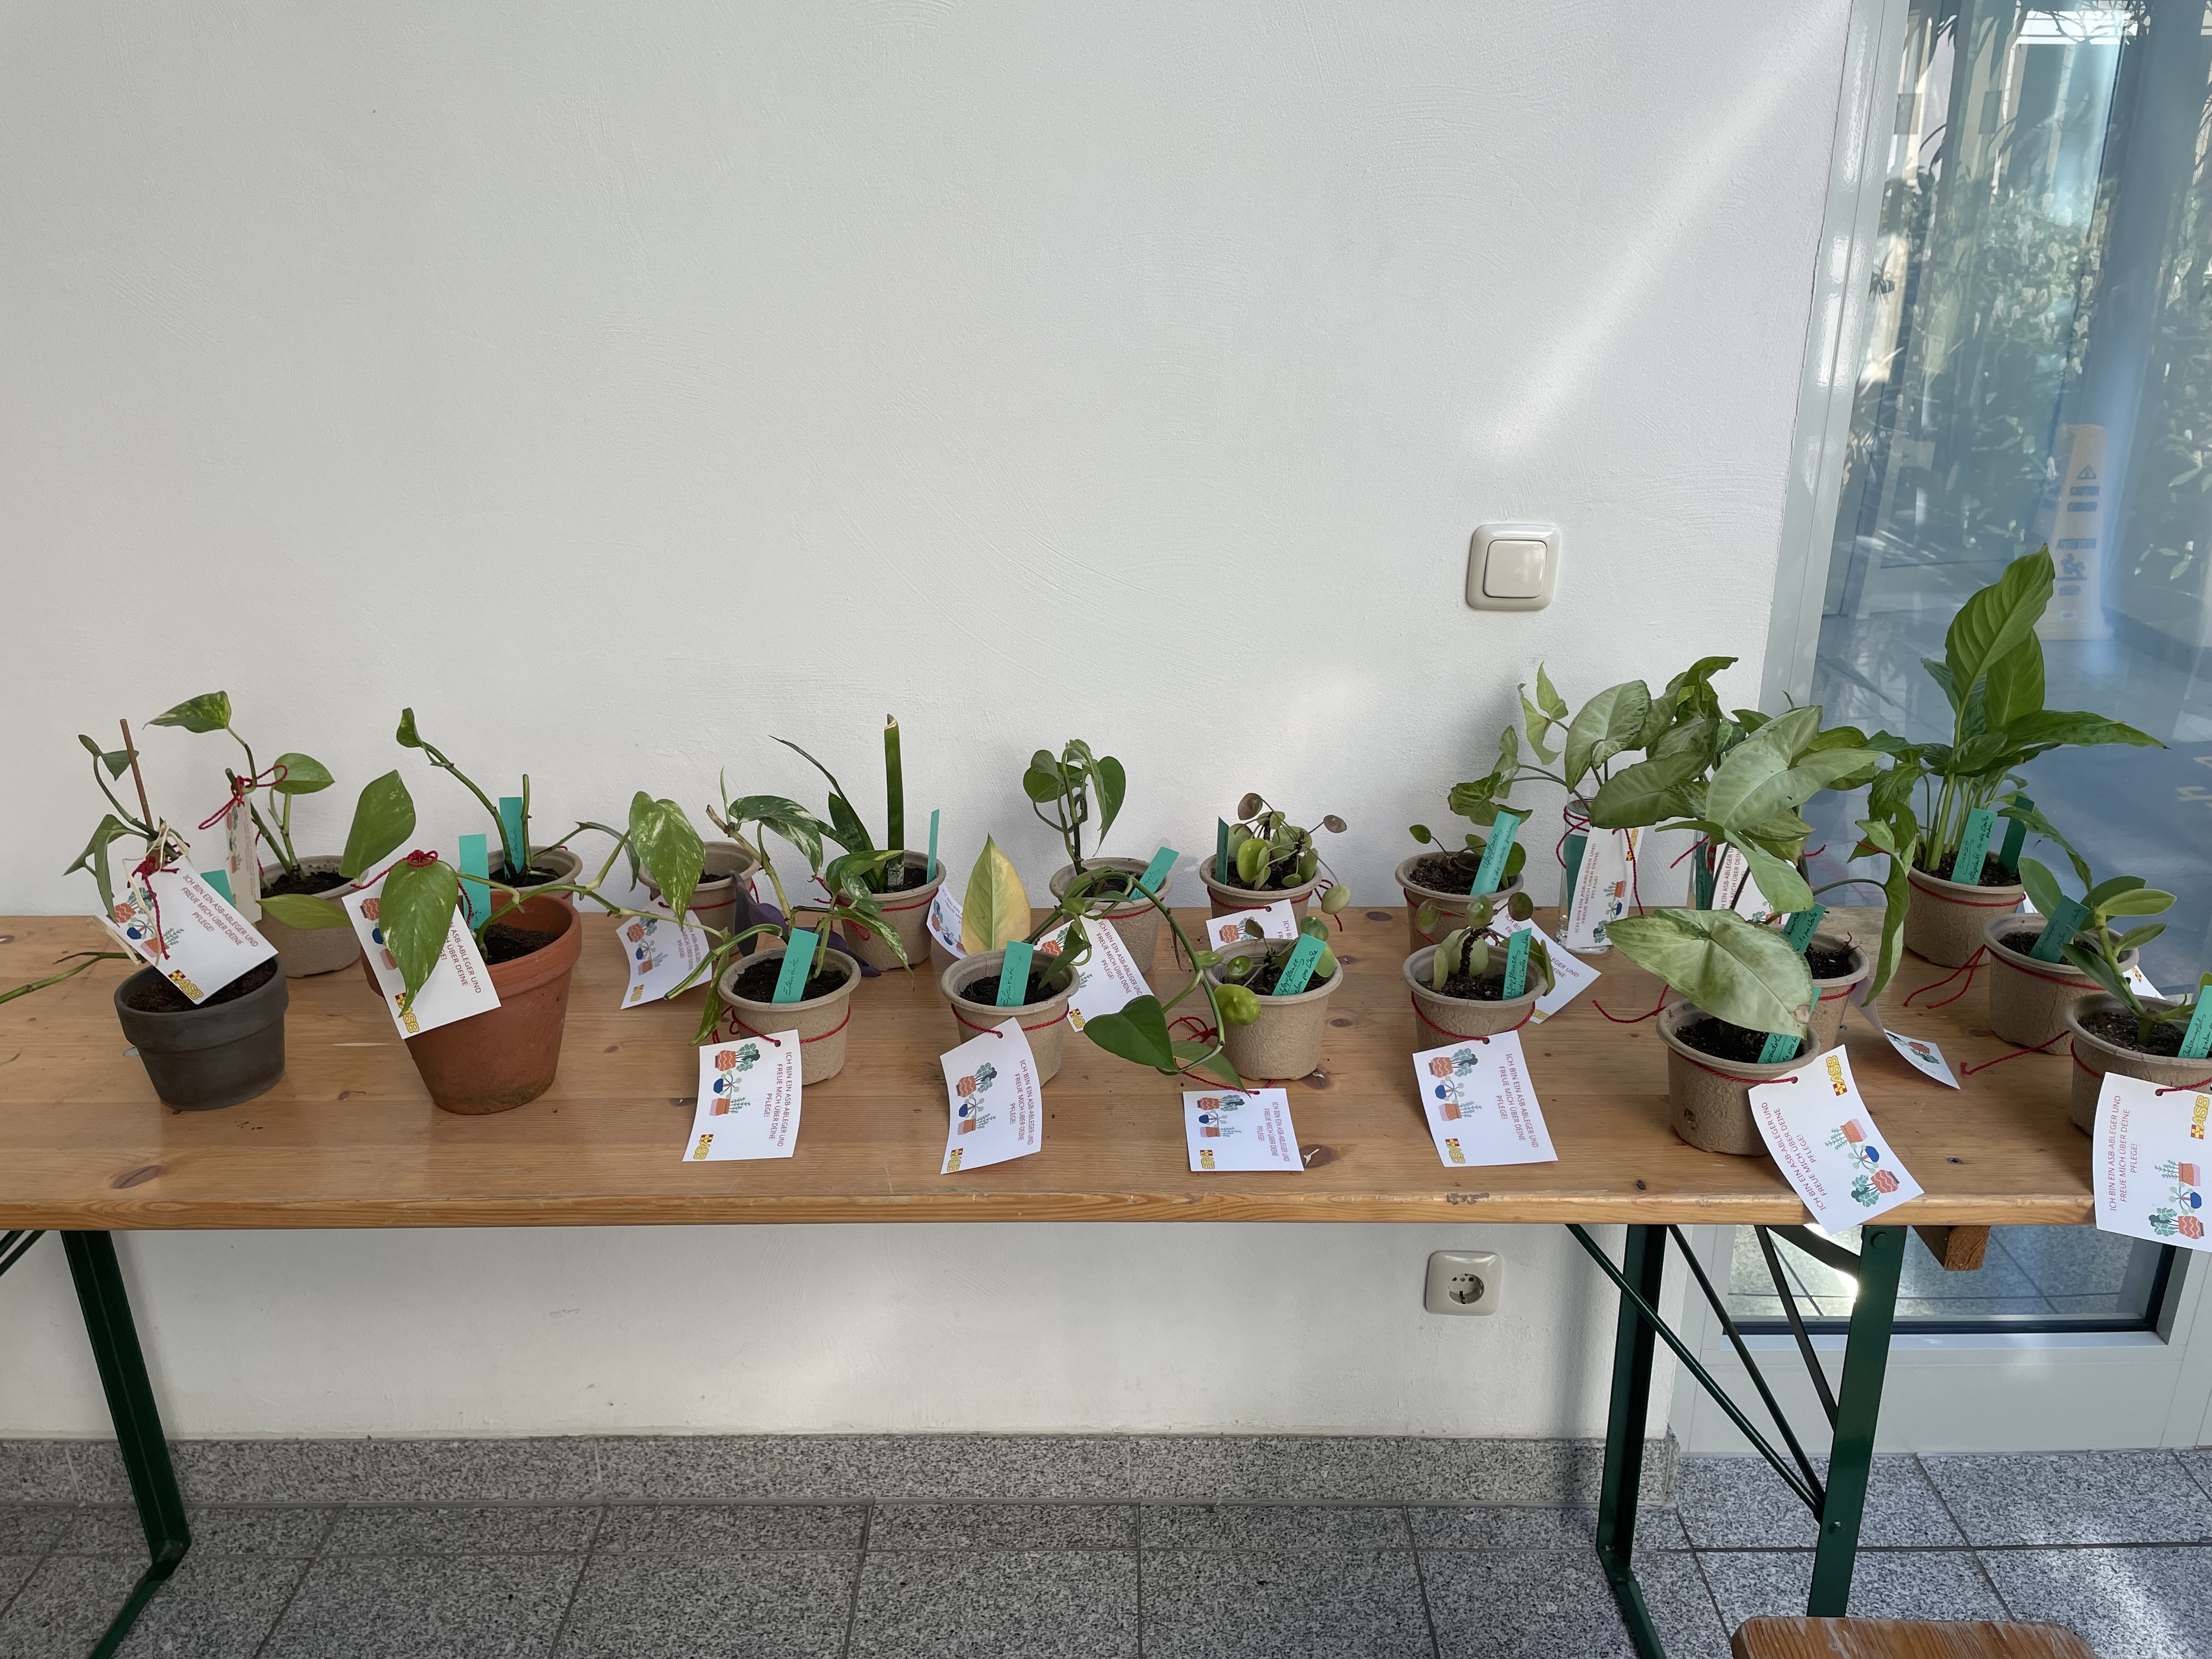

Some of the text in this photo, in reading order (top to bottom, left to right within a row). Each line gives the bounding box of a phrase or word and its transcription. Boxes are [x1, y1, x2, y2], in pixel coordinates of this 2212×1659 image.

[1580, 857, 1593, 898] ASB-ABLEGER
[1587, 870, 1595, 887] ÜBER
[1590, 851, 1600, 870] DEINE
[1722, 853, 1733, 892] ASB-ABLEGER
[1730, 866, 1740, 882] ÜBER
[180, 886, 244, 946] FREUE MICH ÜBER DEINE
[182, 873, 259, 947] ICH BIN EIN ASB-ABLEGER UND
[1720, 892, 1728, 903] EIN
[1282, 919, 1293, 940] ICH BI
[1503, 912, 1516, 925] ICH
[1565, 967, 1579, 978] UND
[446, 943, 469, 986] ÜBER DEINE
[450, 929, 475, 976] ASB-ABLEGER
[470, 975, 482, 994] UND
[1095, 932, 1132, 995] FREUE MICH ÜBER DEINE
[1097, 920, 1143, 996] ICH BIN EIN ASB-ABLEGER UND
[177, 978, 204, 1001] ASB
[1019, 1059, 1028, 1073] ICH
[1023, 1072, 1031, 1086] BIN
[1826, 1055, 1846, 1084] ASB
[774, 1086, 783, 1104] MICH
[785, 1079, 793, 1092] EIN
[1025, 1085, 1033, 1098] EIN
[1498, 1065, 1526, 1141] FREUE MICH ÜBER DEINE
[1505, 1052, 1539, 1148] ICH BIN EIN ASB-ABLEGER UND
[772, 1104, 782, 1122] ÜBER
[780, 1093, 792, 1134] ASB-ABLEGER
[1013, 1073, 1026, 1142] FREUE MICH ÜBER DEINE
[1024, 1098, 1035, 1136] ASB-ABLEGER
[2192, 1094, 2210, 1131] ASB
[768, 1122, 778, 1140] DEINE
[776, 1133, 786, 1147] UND
[693, 1141, 710, 1160] ASB
[947, 1155, 962, 1172] ASB
[1448, 1147, 1466, 1164] ASB
[1760, 1101, 1827, 1211] ICH BIN EIN ASB-ABLEGER UND
[1773, 1107, 1828, 1197] FREUE MICH ÜBER DEINE
[2107, 1094, 2121, 1212] ICH BIN EIN ASB-ABLEGER UND
[2117, 1108, 2130, 1203] FREUE MICH ÜBER DEINE
